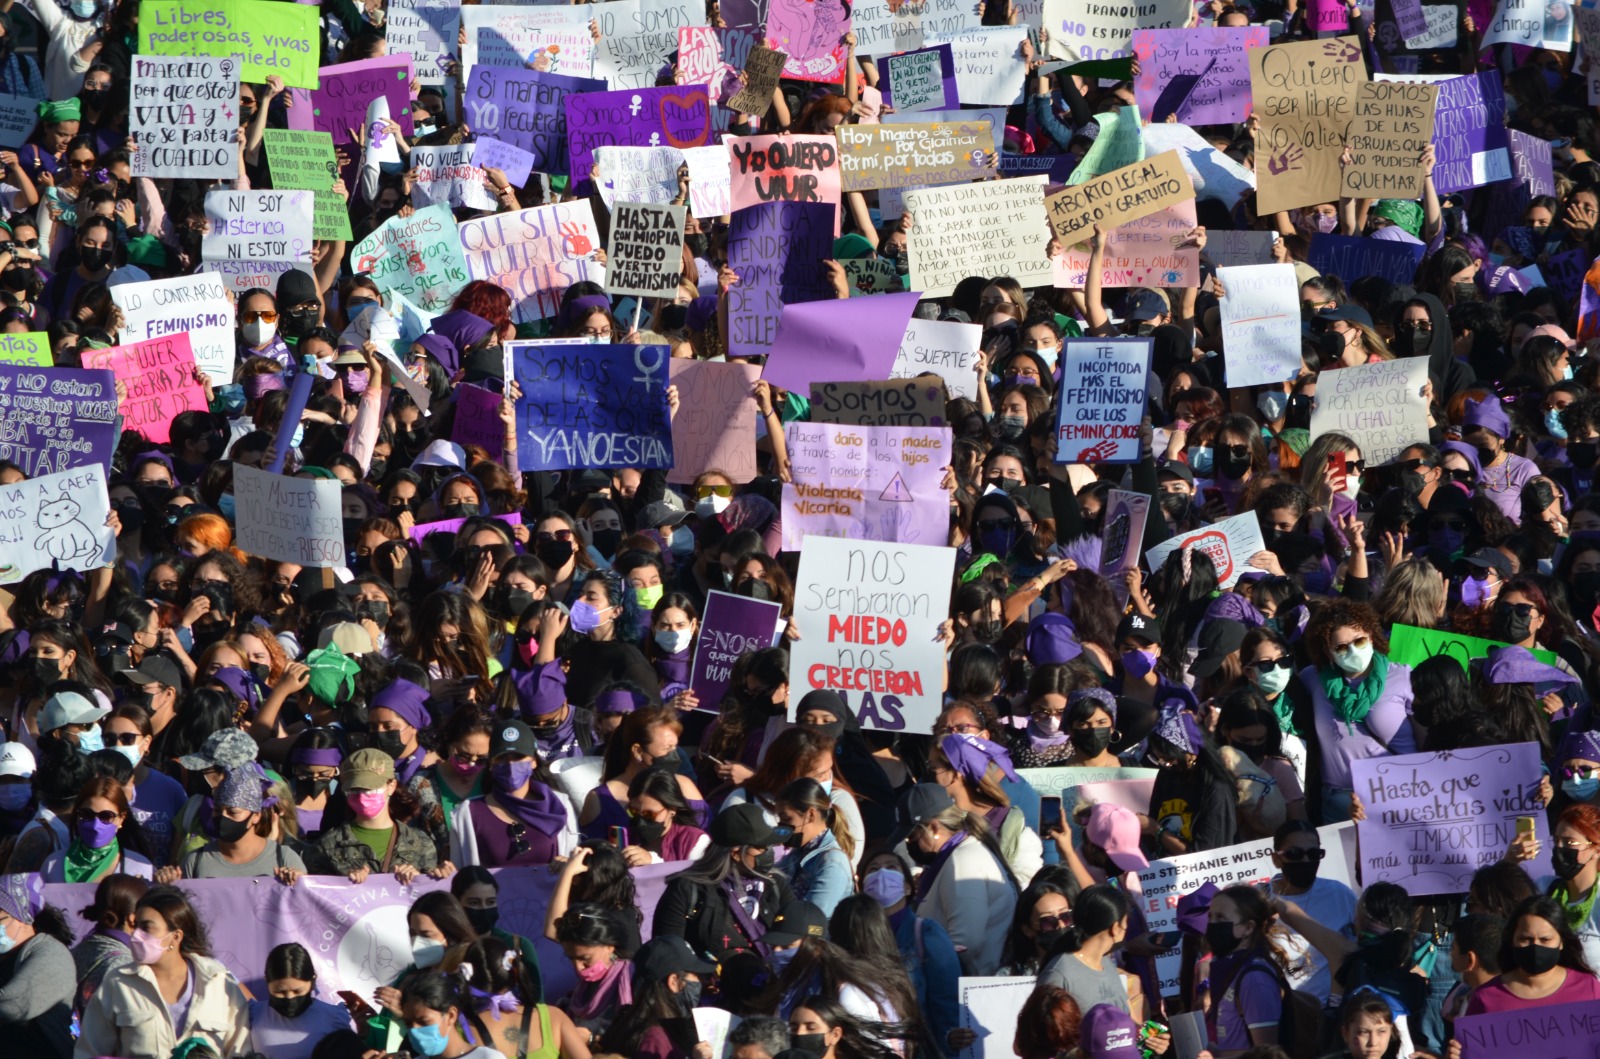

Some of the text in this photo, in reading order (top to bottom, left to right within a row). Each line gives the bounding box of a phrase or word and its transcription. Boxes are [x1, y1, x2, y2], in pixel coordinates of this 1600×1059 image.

[155, 9, 232, 29] Libres,
[1085, 2, 1157, 17] TRANQUILA
[388, 15, 425, 28] LUCHO
[632, 6, 691, 35] SOMOS
[1061, 19, 1108, 39] NO ES
[1493, 17, 1541, 40] chingo
[149, 29, 311, 53] poderosas, vivas
[621, 50, 662, 68] SOMOS
[134, 81, 238, 102] por que estoy
[1227, 78, 1251, 89] vas
[1361, 83, 1431, 102] SOMOS
[135, 104, 216, 126] VIVA y
[1355, 103, 1425, 119] LAS HIJAS
[1365, 119, 1420, 133] DE LAS
[840, 127, 929, 147] Hoy marcho
[1351, 135, 1429, 151] BRUJAS QUE
[883, 153, 909, 172] por
[912, 148, 956, 168] todas
[1349, 154, 1423, 168] NO PUDISTE
[1346, 171, 1417, 191] QUEMAR
[228, 195, 284, 212] NI SOY
[1052, 179, 1113, 216] ABORTO
[1056, 178, 1181, 237] SEGURO Y GRATUITO
[616, 207, 676, 230] HASTA
[731, 203, 812, 233] NUNCA
[920, 207, 937, 221] YA
[939, 204, 956, 218] NO
[459, 214, 509, 252] QUE
[911, 211, 1028, 236] QUE SABER QUE ME
[613, 229, 681, 247] CON MIOPIA
[913, 228, 1011, 249] FUI AMANDOTE
[915, 233, 1043, 263] Y EN NOMBRE DE ESE
[228, 241, 287, 259] NI ESTOY
[612, 242, 666, 261] PUEDO
[615, 259, 662, 273] VER TU
[918, 250, 1017, 273] AMOR TE SUPLICO
[1017, 258, 1051, 273] TODO
[1116, 254, 1189, 270] EN EL OLVIDO
[235, 275, 271, 288] GRITO
[610, 271, 680, 291] MACHISMO
[124, 283, 225, 312] LO CONTRARIO
[126, 313, 228, 338] AL FEMINISMO
[1096, 347, 1113, 359] TE
[519, 346, 613, 386] SOMOS
[1078, 361, 1142, 374] INCOMODA
[17, 374, 103, 397] NO estan
[1109, 375, 1125, 387] EL
[13, 394, 119, 420] nuestras VOCES
[823, 382, 917, 412] SOMOS
[1067, 388, 1144, 405] FEMINISMO
[55, 412, 70, 428] la
[1076, 407, 1128, 422] QUE LOS
[36, 426, 75, 440] no se
[788, 426, 943, 449] Hacer daño a la madre
[45, 437, 93, 453] puede
[846, 448, 862, 461] de
[874, 448, 892, 462] los
[901, 450, 930, 468] hijos
[6, 471, 99, 503] VA A CAER
[268, 481, 322, 510] MUJER
[794, 481, 864, 502] Violencia
[793, 500, 853, 517] Vicaria
[296, 537, 343, 563] RIESGO
[846, 549, 908, 586] nos
[827, 614, 908, 648] MIEDO
[837, 648, 895, 670] nos
[807, 663, 925, 697] CRECIERON
[1367, 768, 1482, 806] Hasta que
[1381, 783, 1546, 825] nuestras vidas
[1409, 822, 1509, 852] IMPORTEN
[1159, 847, 1274, 879] STEPHANIE WILSO
[1368, 851, 1471, 876] más que sus
[1181, 878, 1200, 890] del
[1237, 866, 1258, 882] por
[319, 886, 391, 953] COLECTIVA
[1462, 1023, 1499, 1049] NI
[1505, 1015, 1566, 1047] UNA
